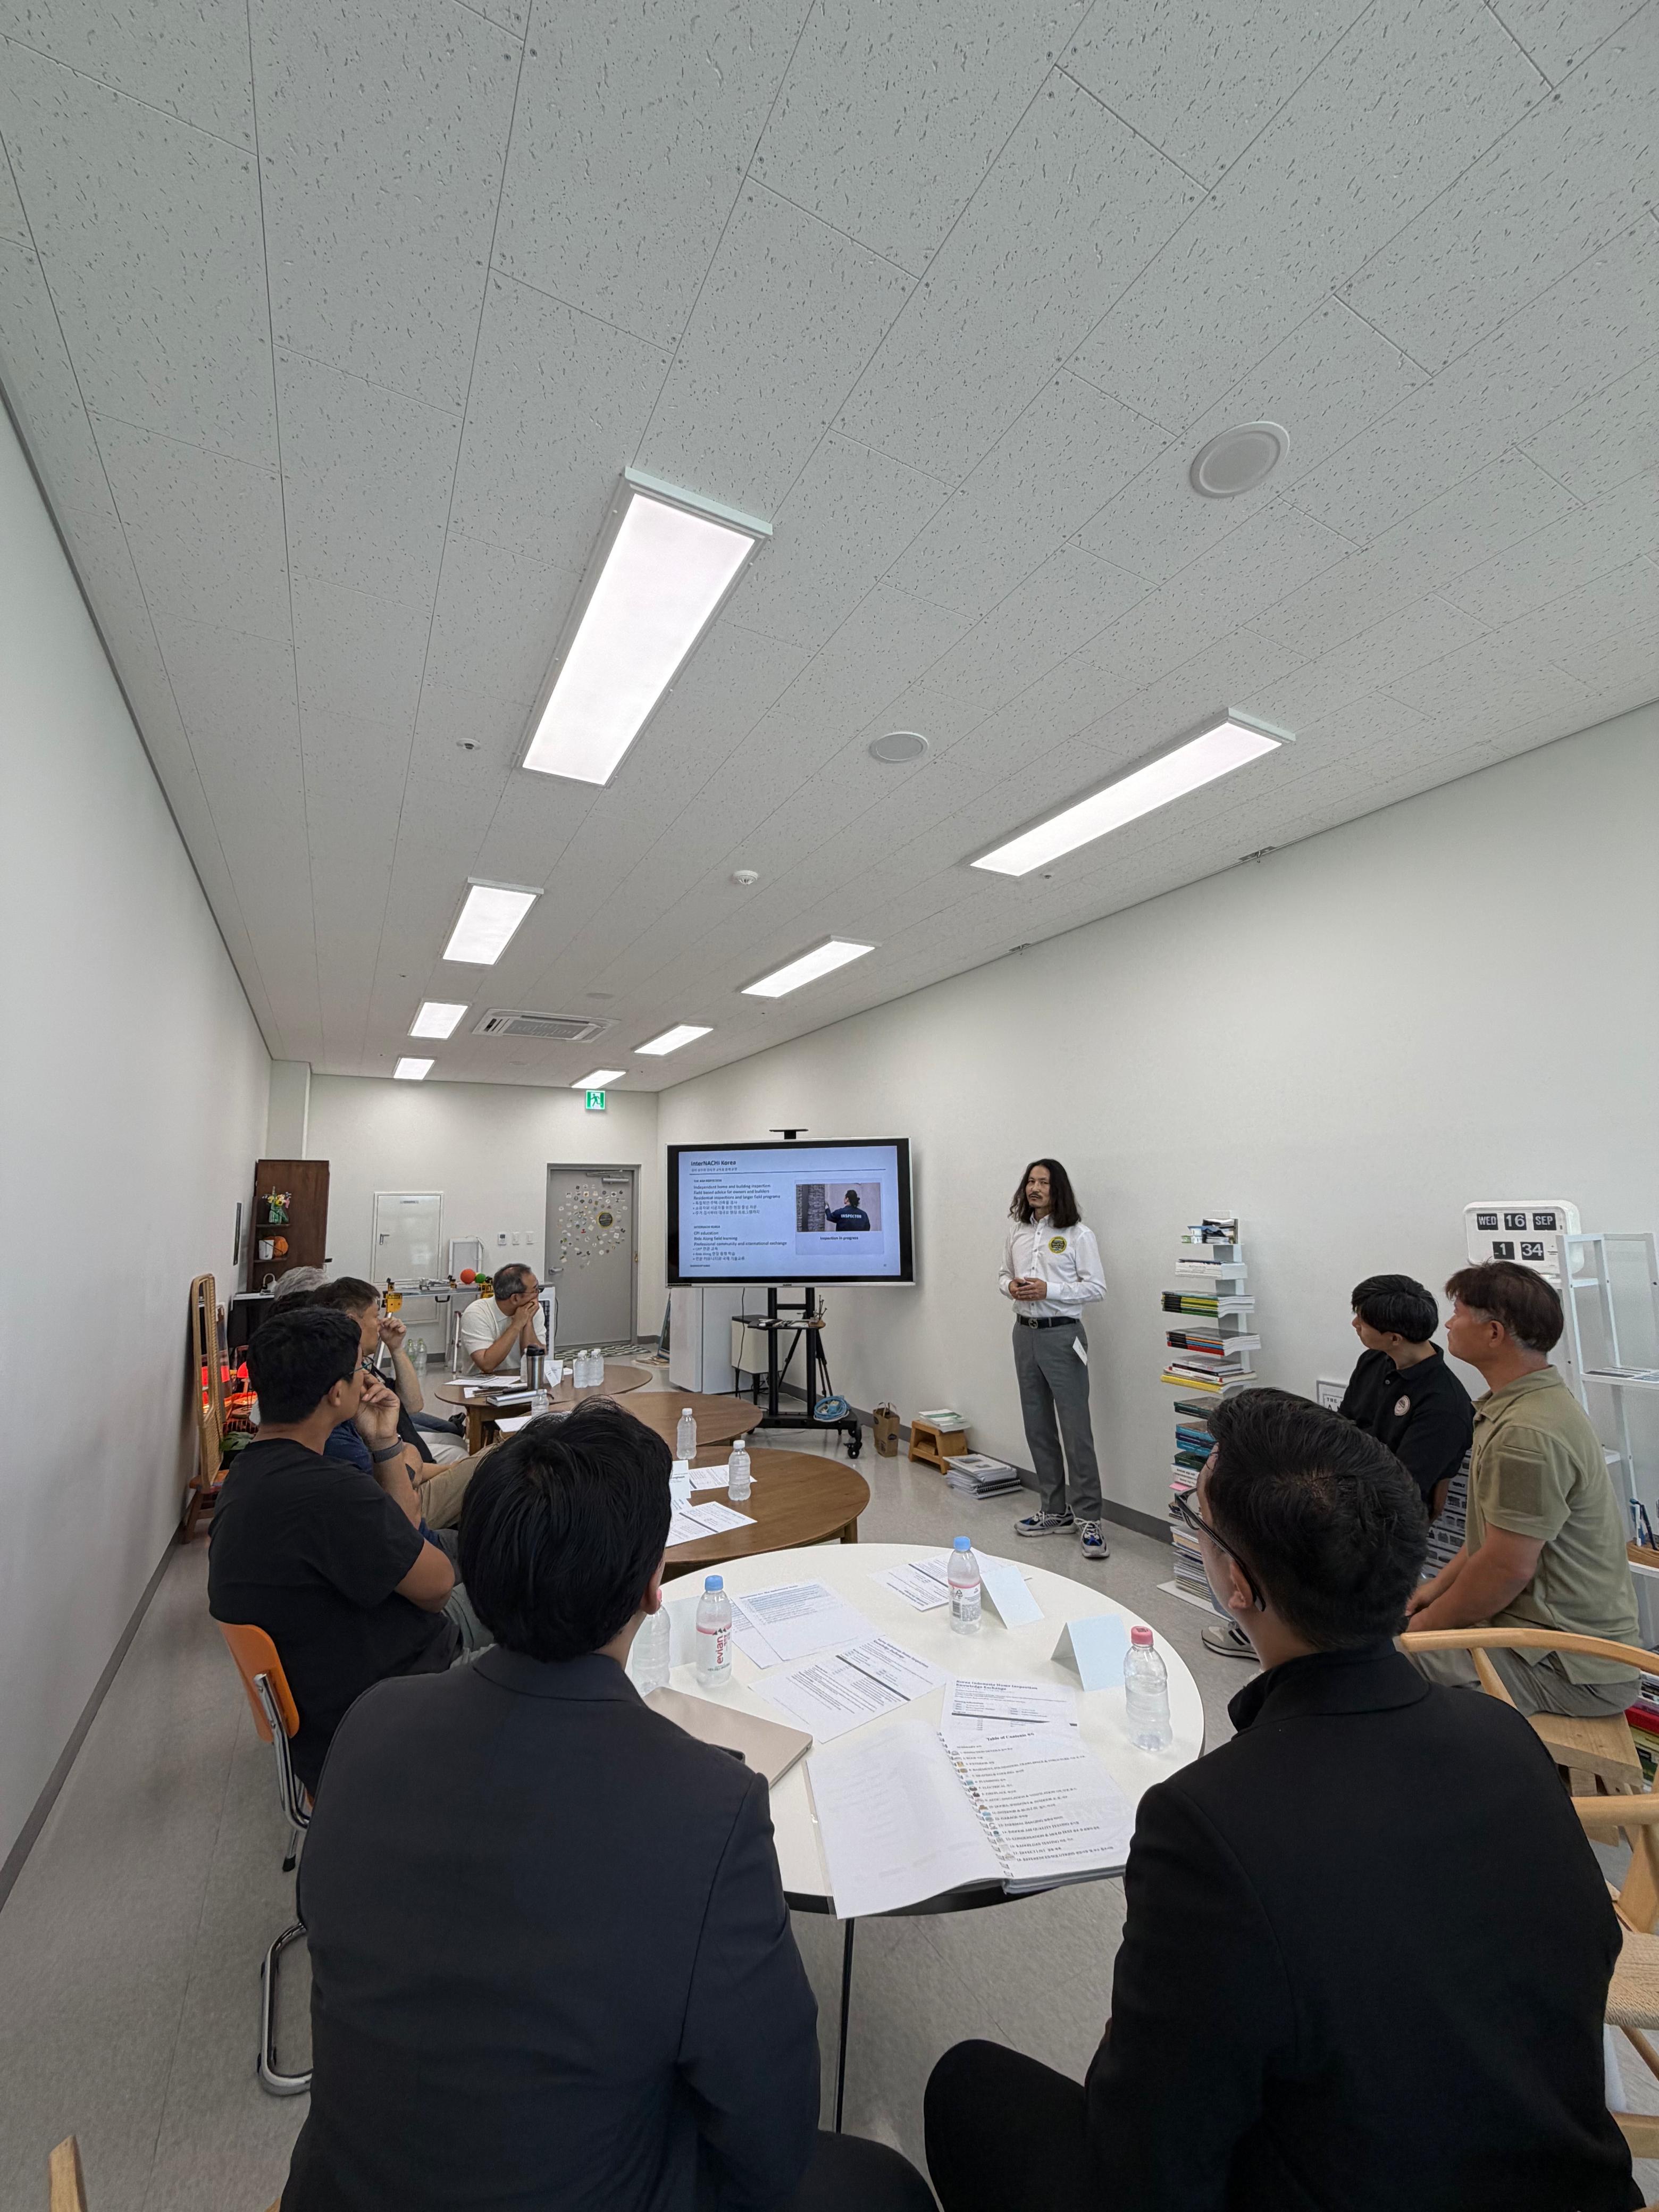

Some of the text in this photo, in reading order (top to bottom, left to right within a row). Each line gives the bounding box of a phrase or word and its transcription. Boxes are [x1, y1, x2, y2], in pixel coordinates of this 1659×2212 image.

[1478, 1214, 1553, 1227] WED 16 SEP
[1499, 1243, 1543, 1256] 1 34
